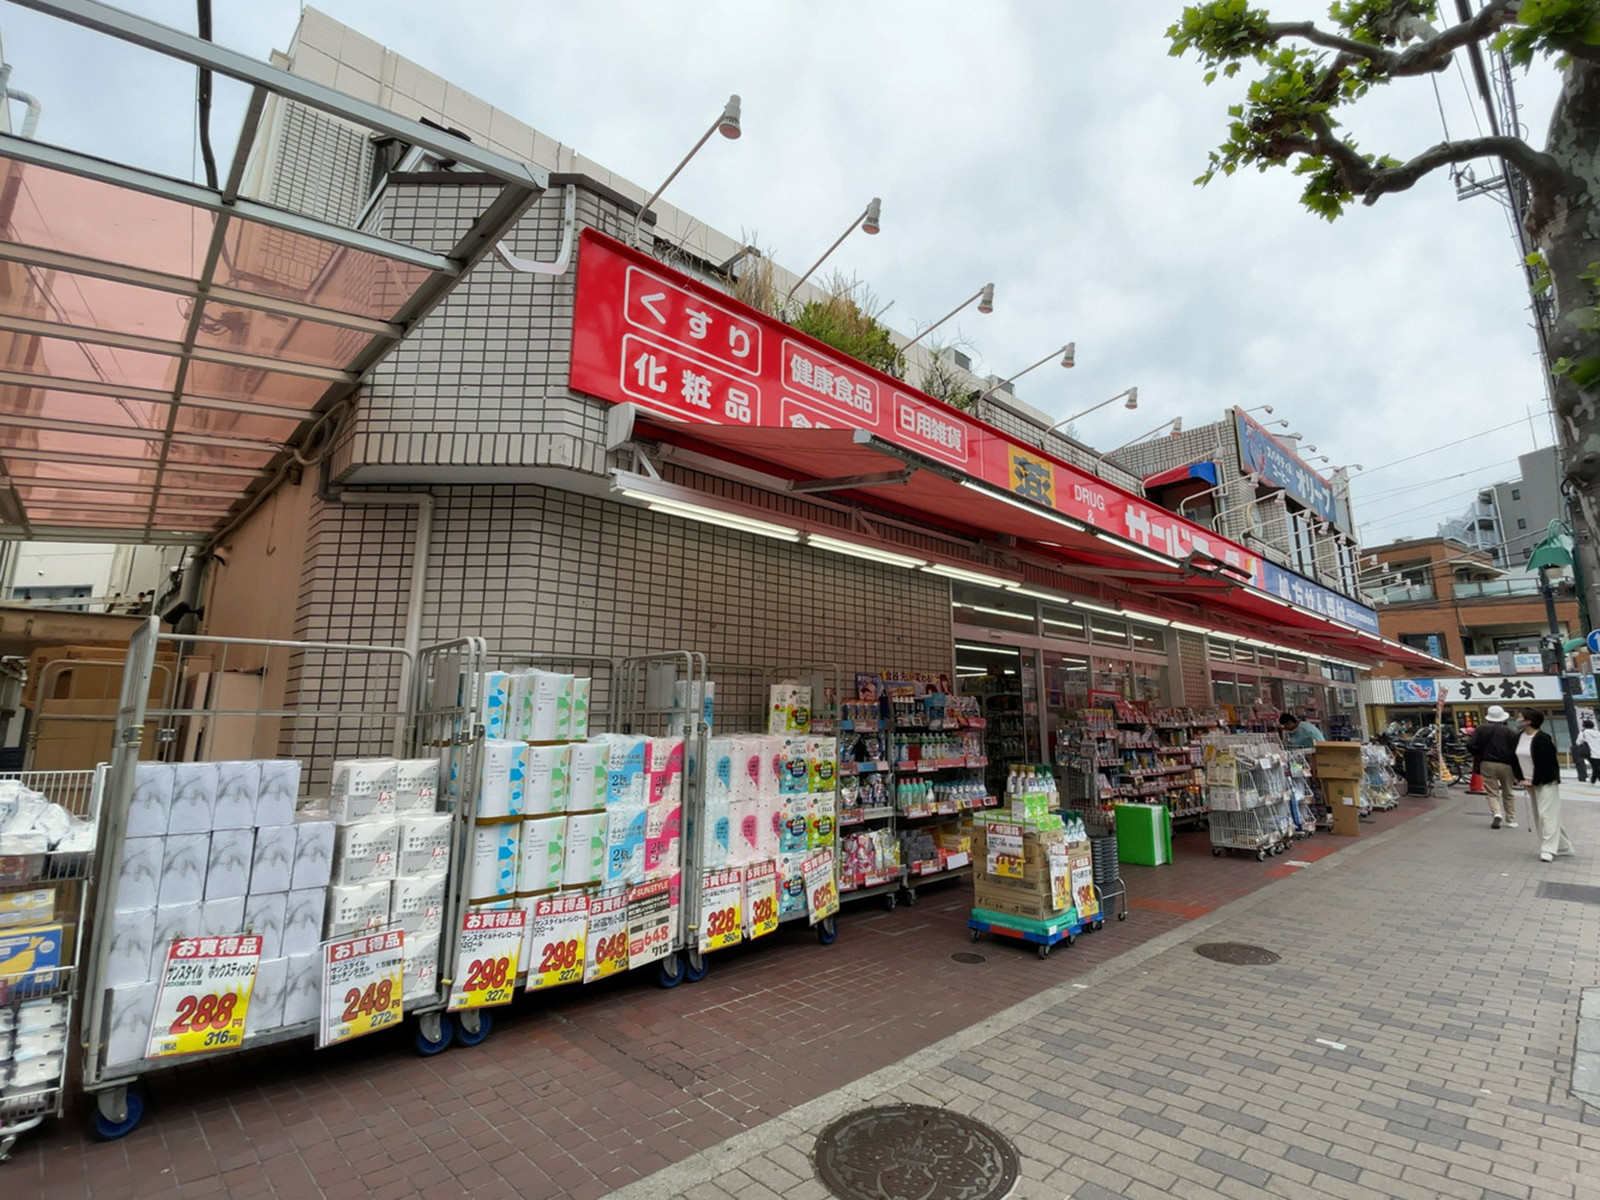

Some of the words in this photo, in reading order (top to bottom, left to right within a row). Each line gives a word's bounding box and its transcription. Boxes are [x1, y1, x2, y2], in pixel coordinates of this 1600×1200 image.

[640, 292, 751, 359] くすり
[634, 352, 752, 424] 化粧品
[789, 354, 873, 415] 健康食品
[899, 404, 962, 453] 日用雑貨
[1074, 484, 1105, 511] DRUG
[1459, 678, 1536, 700] すし松
[636, 880, 669, 897] SUNSTYLE
[539, 897, 587, 914] お買得品
[467, 912, 522, 929] お買得品
[176, 937, 258, 957] お買得品
[335, 932, 400, 960] お買得品
[595, 933, 627, 964] 648
[644, 925, 669, 946] 648
[538, 939, 583, 973] 298円
[652, 943, 669, 956] 712
[168, 964, 204, 980] サンスタイル
[463, 957, 514, 992] 298円
[168, 992, 244, 1035] 288円
[342, 979, 401, 1023] 248円
[370, 1011, 398, 1028] 272円
[204, 1030, 238, 1047] 316円
